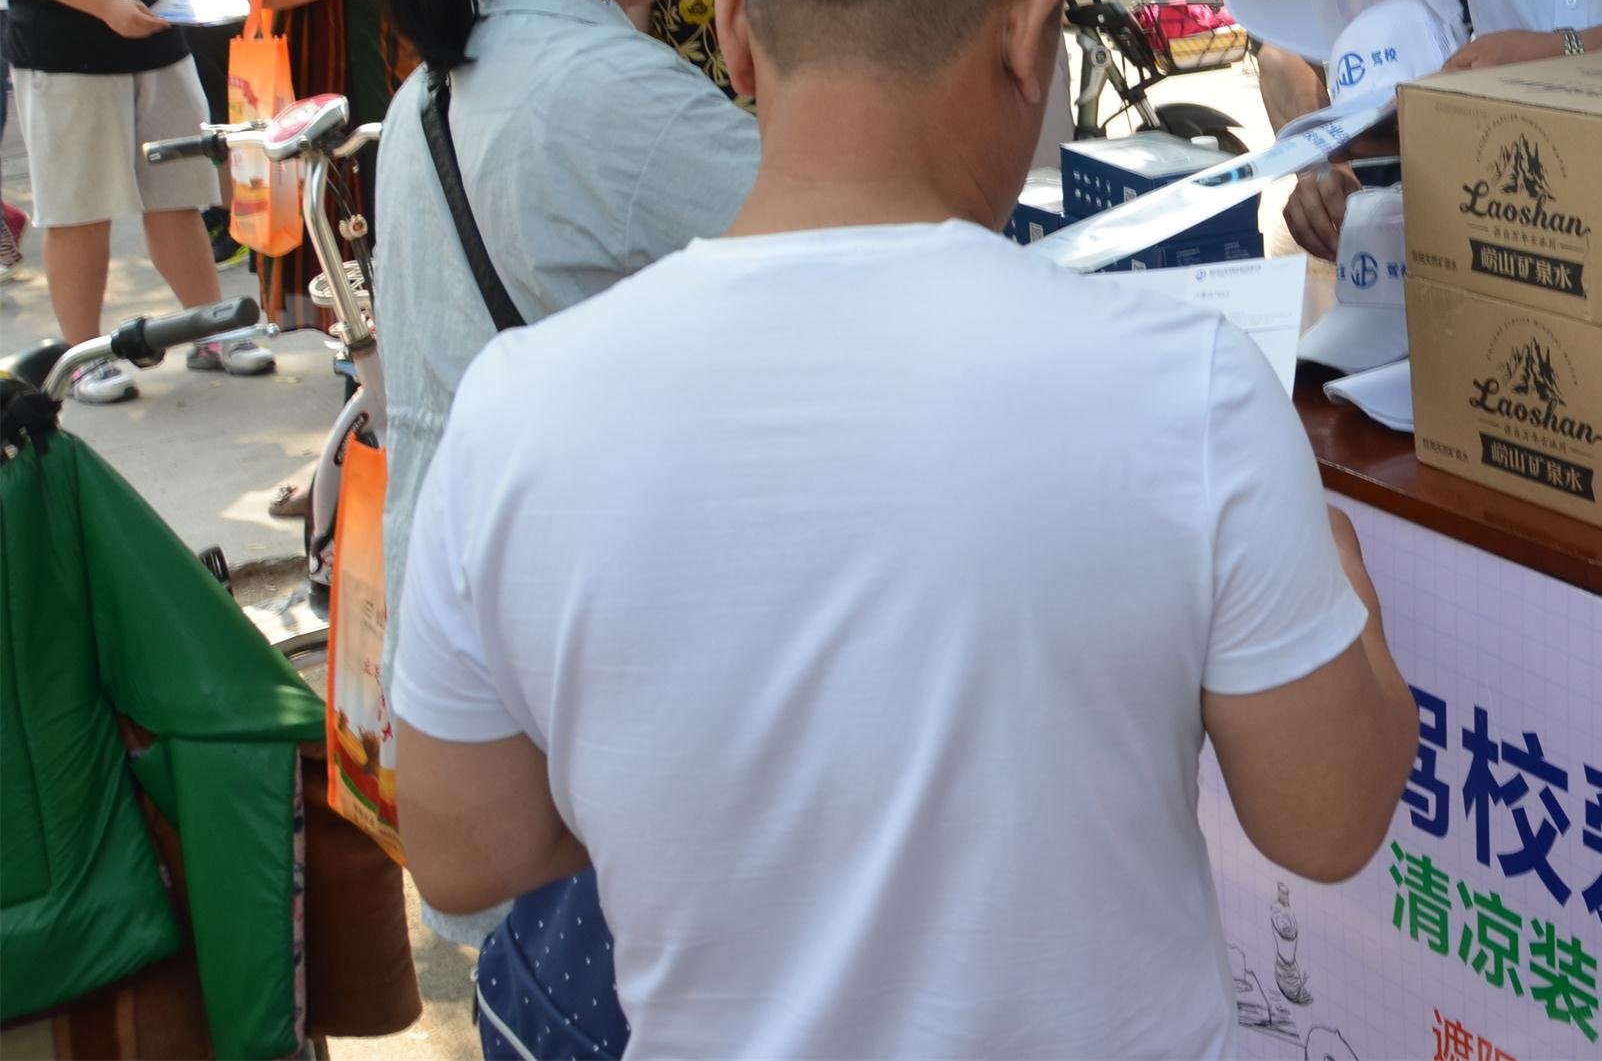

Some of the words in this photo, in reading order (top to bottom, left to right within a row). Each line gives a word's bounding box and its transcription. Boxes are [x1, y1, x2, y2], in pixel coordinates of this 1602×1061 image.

[1460, 181, 1591, 237] Laoshan
[1481, 245, 1574, 290] 崂山矿泉水
[1469, 378, 1602, 445] Laoshan
[1491, 440, 1584, 492] 崂山矿泉水
